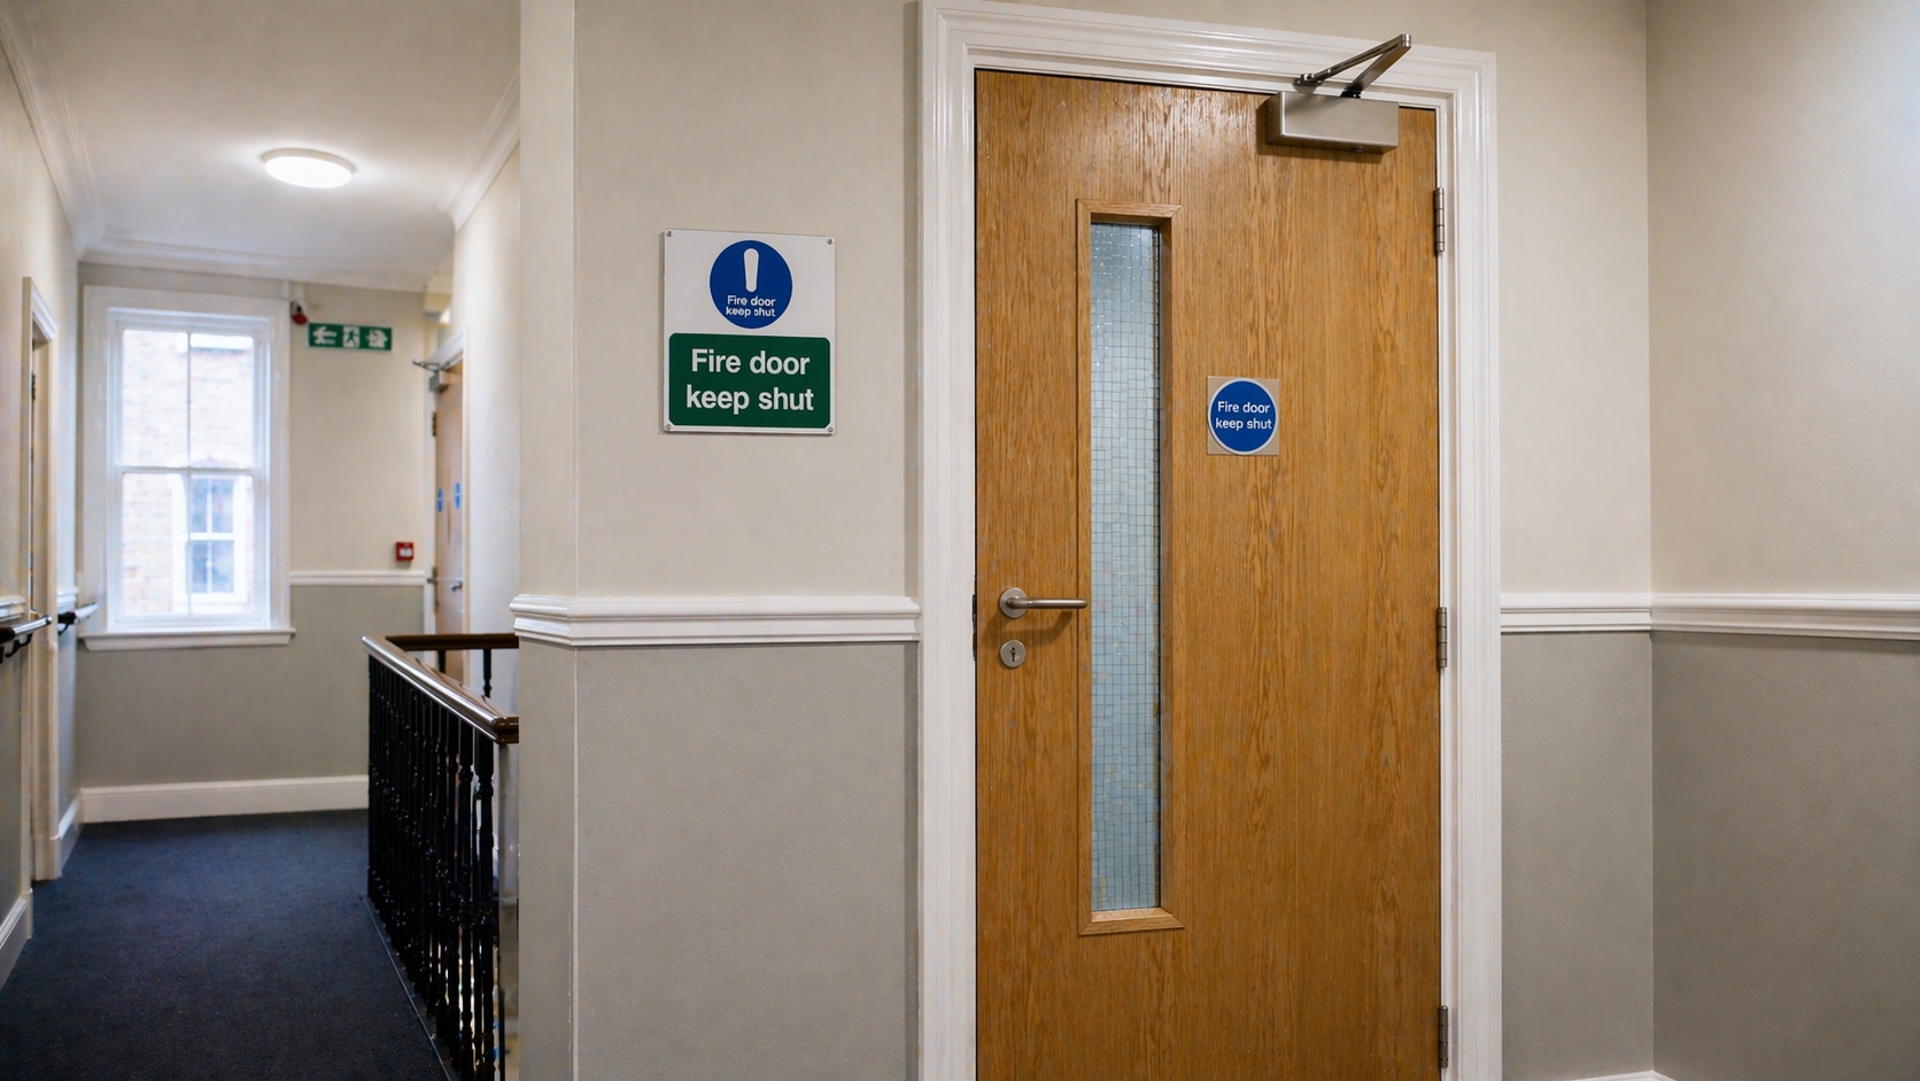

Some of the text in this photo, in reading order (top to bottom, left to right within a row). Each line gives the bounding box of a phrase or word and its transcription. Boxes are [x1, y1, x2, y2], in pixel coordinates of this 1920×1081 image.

[727, 294, 776, 307] Fire door
[691, 348, 810, 375] Fire door
[686, 384, 814, 415] keep shut
[1217, 401, 1271, 413] Fire door
[1215, 417, 1272, 431] keep shut
